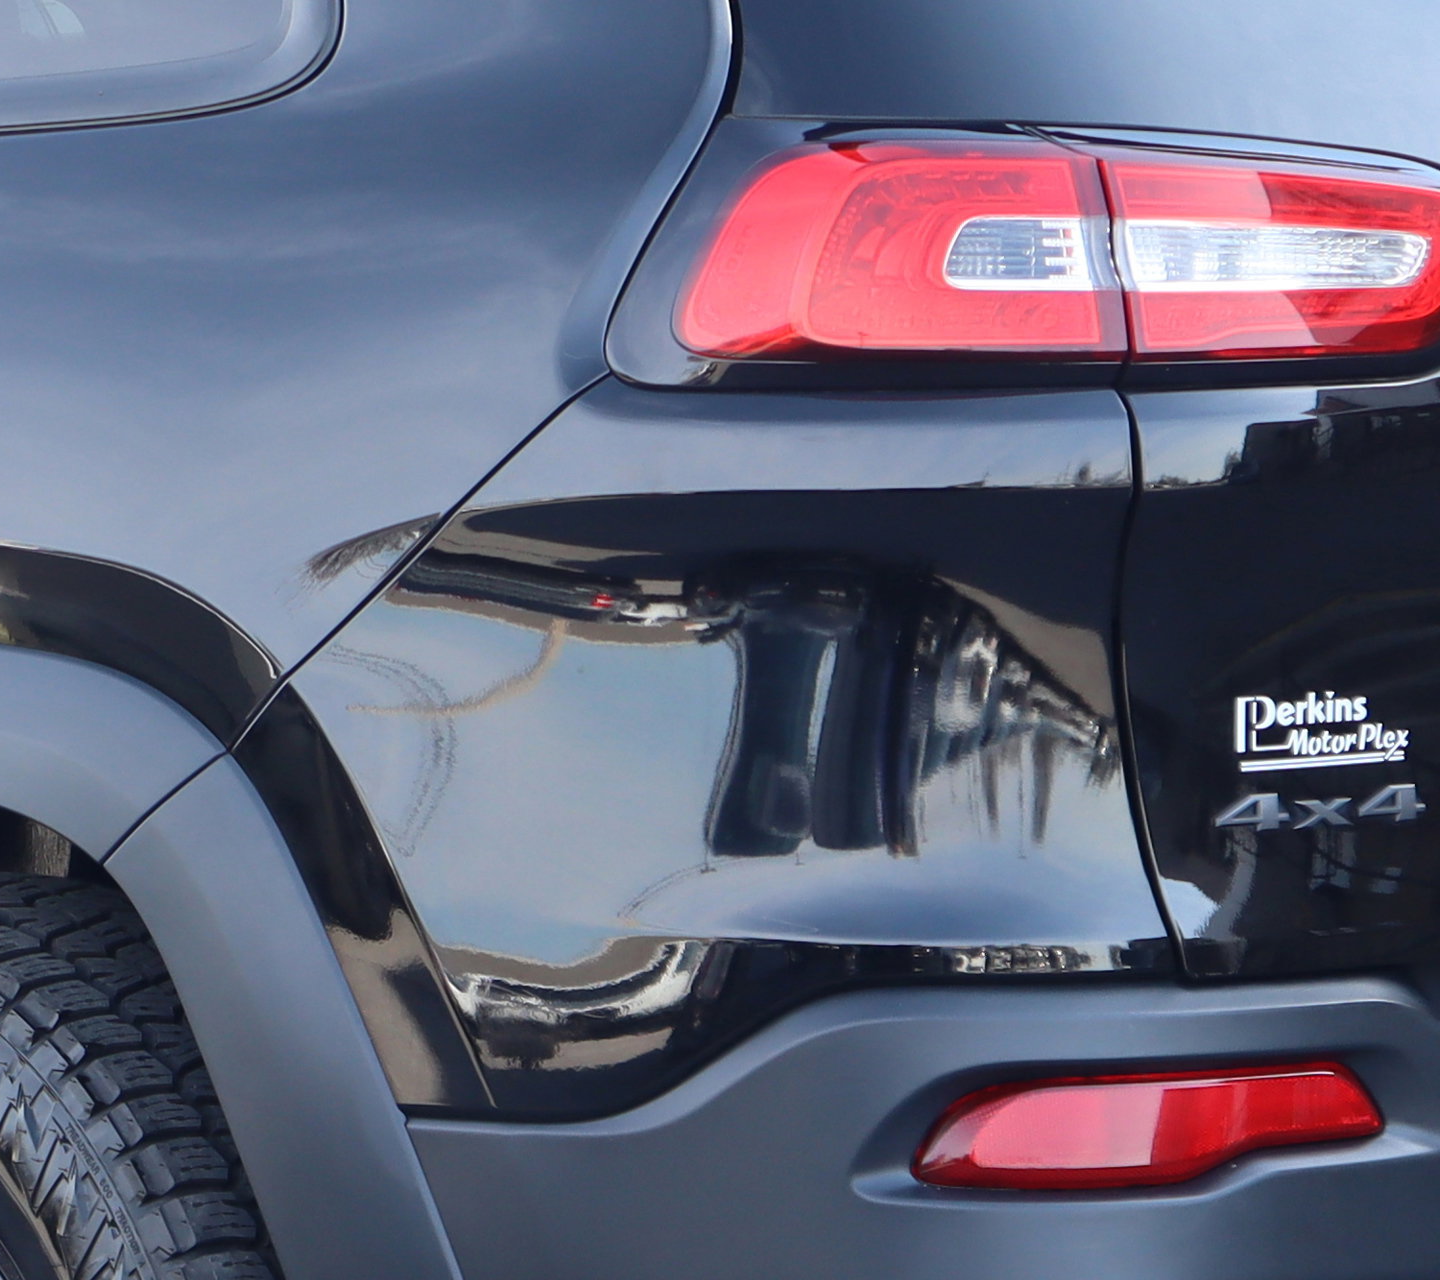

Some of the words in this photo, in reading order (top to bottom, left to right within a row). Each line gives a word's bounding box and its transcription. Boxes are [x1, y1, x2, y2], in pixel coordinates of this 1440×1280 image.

[1235, 691, 1368, 753] Perkins
[1214, 783, 1427, 832] 4x4
[64, 1124, 100, 1179] TREADWEAR
[114, 1207, 142, 1257] TRACTION
